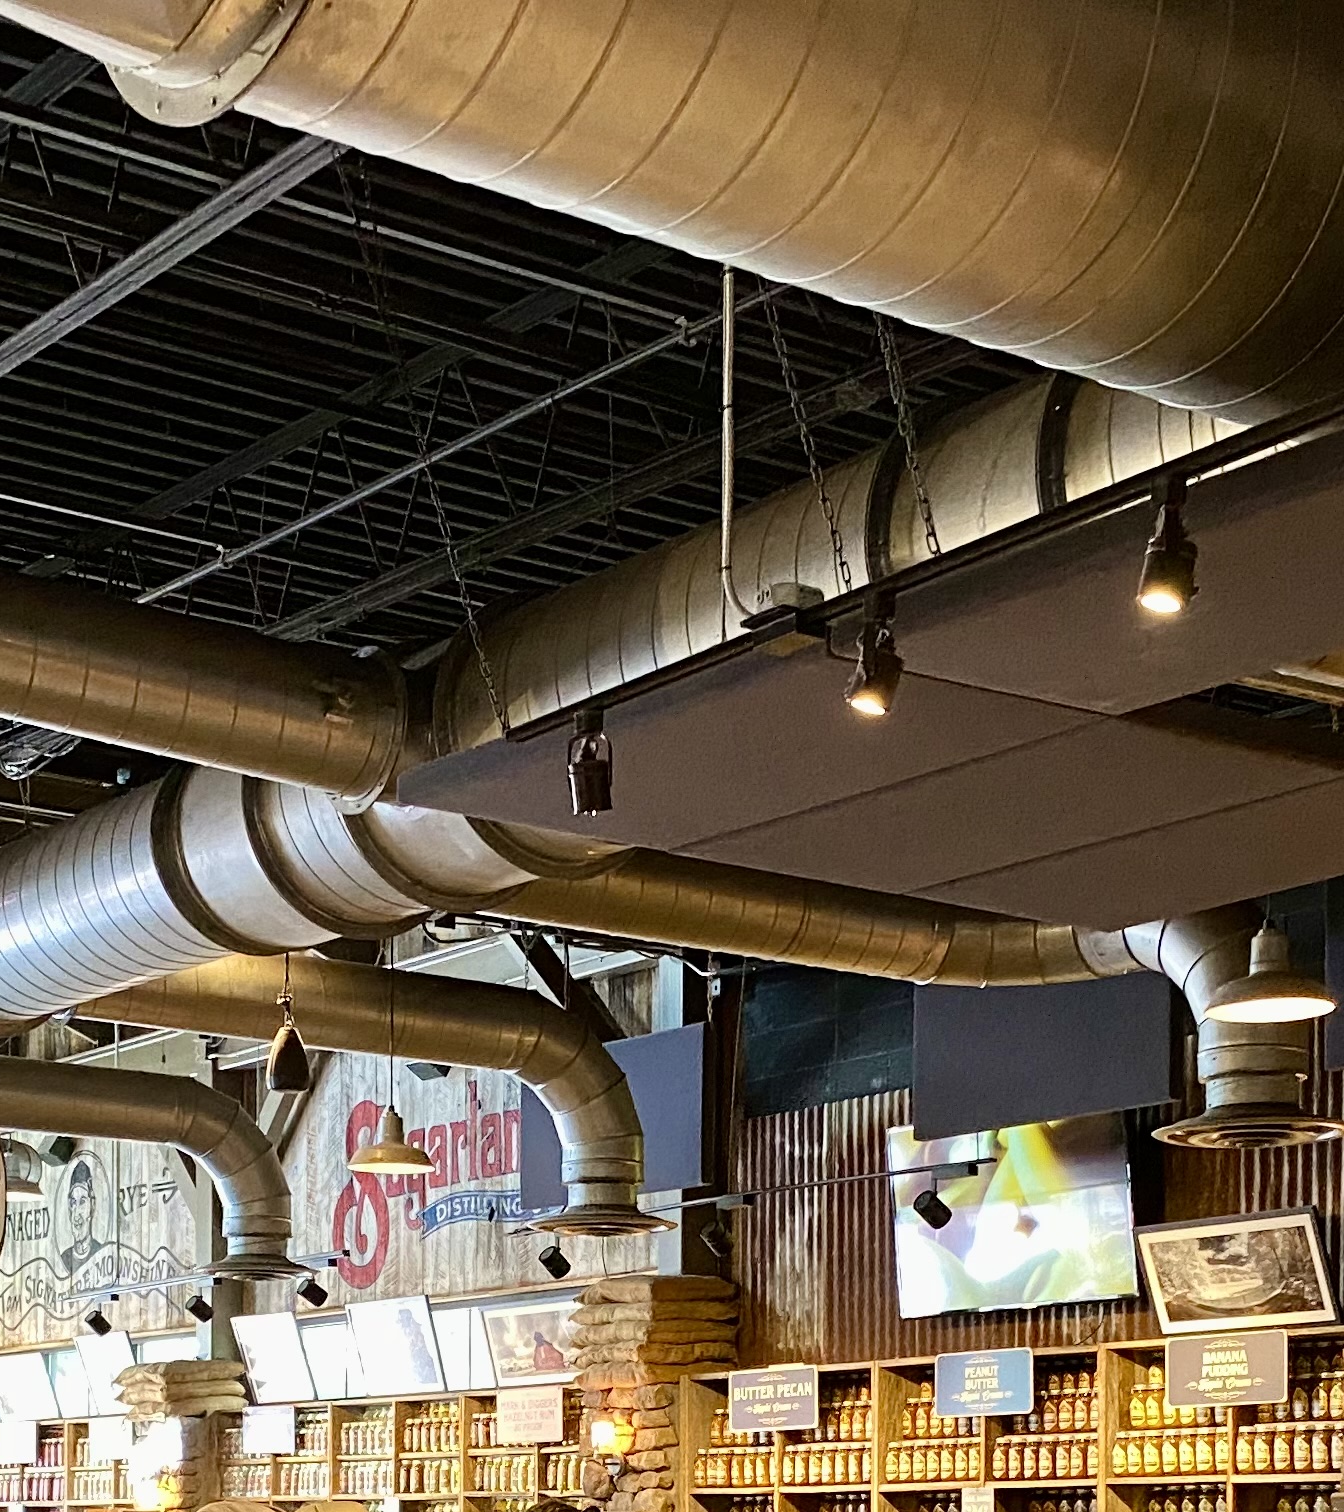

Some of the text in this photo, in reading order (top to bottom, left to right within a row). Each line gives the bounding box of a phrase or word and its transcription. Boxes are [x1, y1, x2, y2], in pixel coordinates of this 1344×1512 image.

[7, 1184, 148, 1242] NAGED RYE
[1202, 1349, 1247, 1364] BANANA
[964, 1365, 999, 1379] PEANUT
[1201, 1362, 1249, 1378] PUDDING
[964, 1377, 999, 1390] BUTTER
[734, 1382, 813, 1402] BUTTER PECAN
